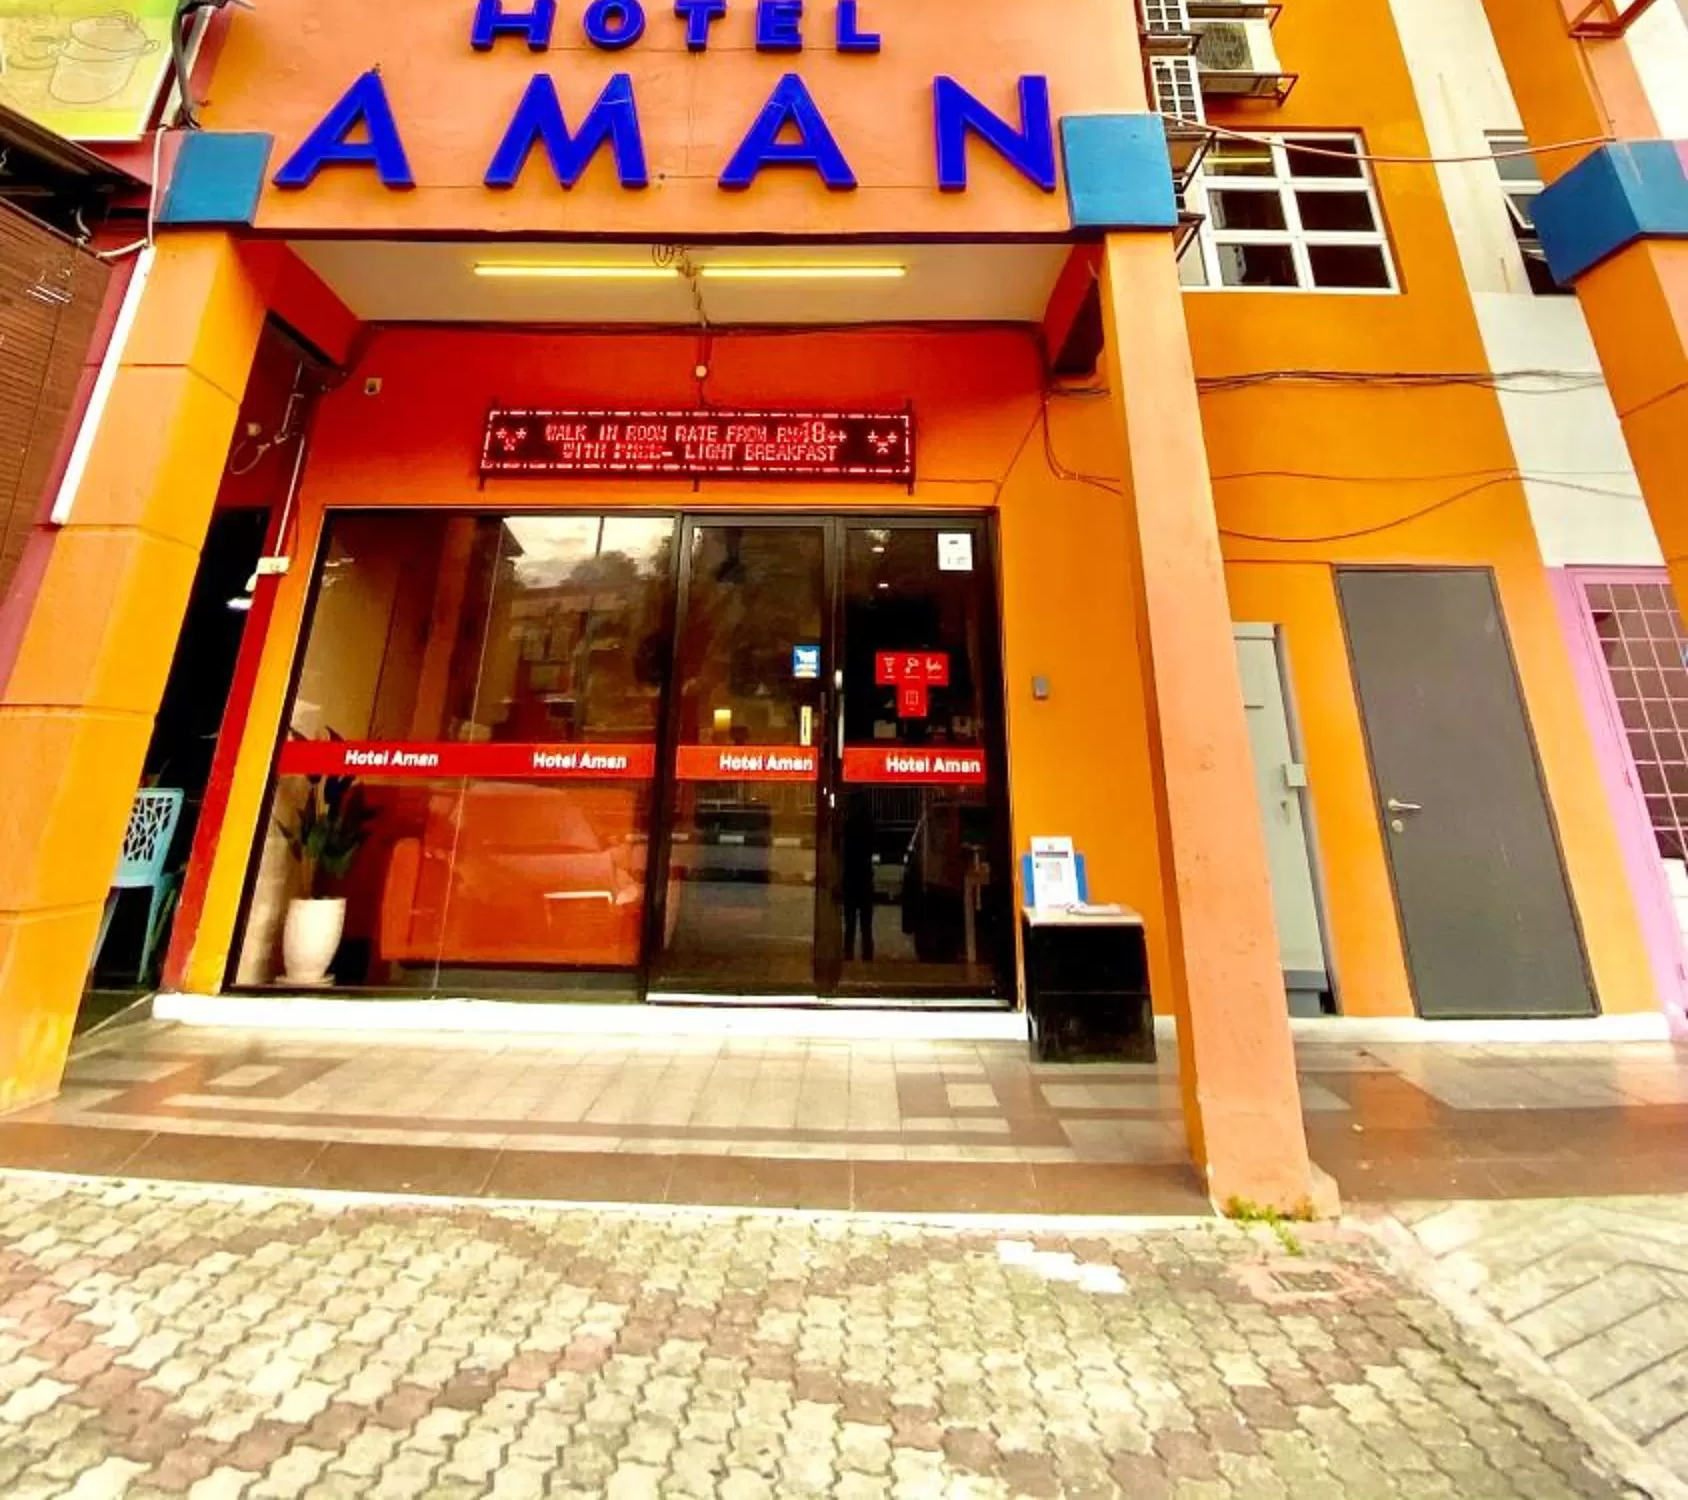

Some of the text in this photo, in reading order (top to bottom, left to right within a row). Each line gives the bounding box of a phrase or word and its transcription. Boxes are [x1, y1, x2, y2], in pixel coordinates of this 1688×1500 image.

[271, 71, 1058, 193] AMAN
[545, 424, 588, 442] WALK
[599, 424, 619, 442] IN
[625, 425, 669, 443] ROOM
[675, 425, 719, 443] RATE
[726, 425, 768, 443] FROM
[563, 442, 607, 460] WITH
[684, 443, 737, 460] LIGHT
[744, 444, 838, 462] BREAKFAST
[344, 749, 439, 767] Hotel Aman
[532, 751, 627, 769] Hotel Aman
[719, 754, 813, 771] Hotel Aman
[886, 756, 981, 774] Hotel Aman
